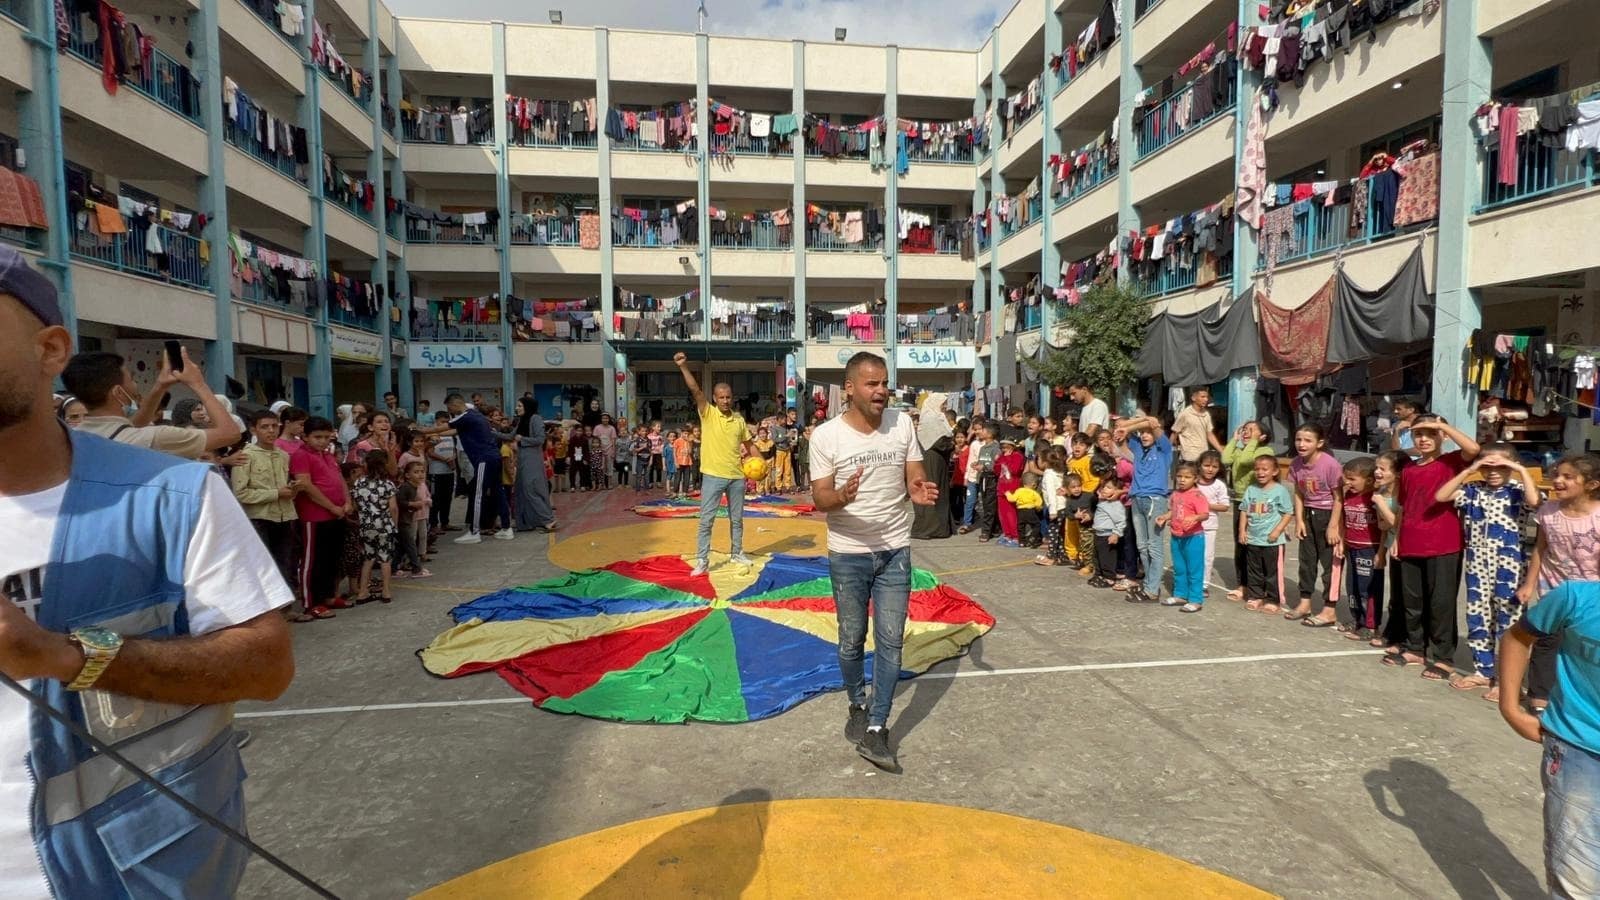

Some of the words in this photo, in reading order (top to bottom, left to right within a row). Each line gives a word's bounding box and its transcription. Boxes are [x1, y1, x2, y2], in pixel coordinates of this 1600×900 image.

[421, 346, 483, 367] الحيادية
[908, 347, 957, 367] النزاهة
[850, 451, 897, 465] TEMPORARY
